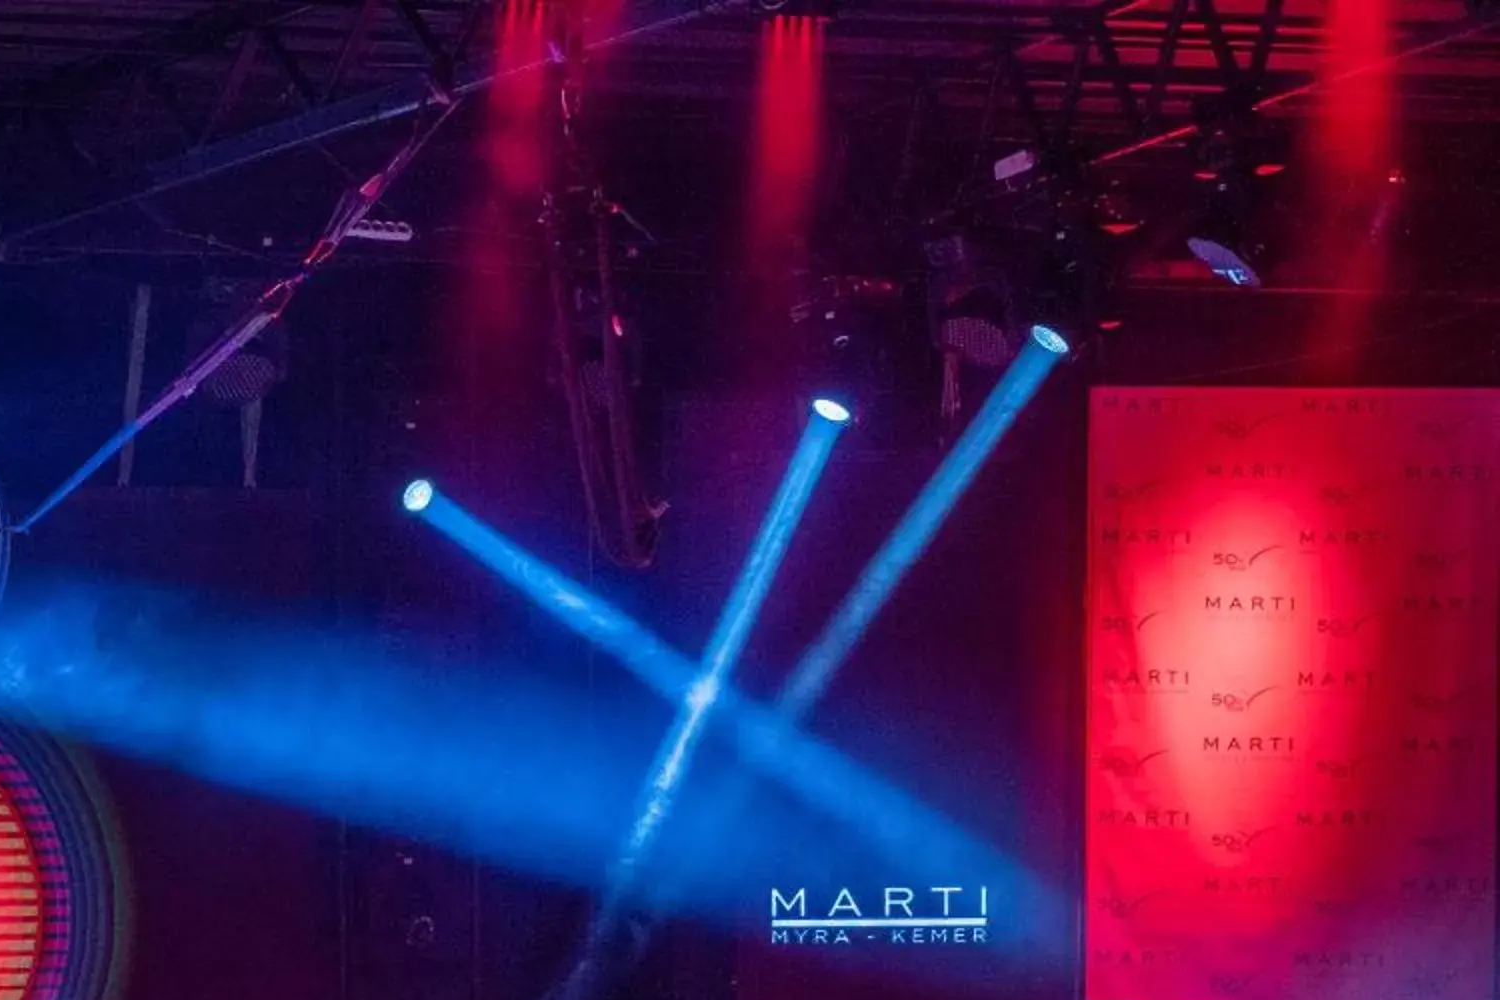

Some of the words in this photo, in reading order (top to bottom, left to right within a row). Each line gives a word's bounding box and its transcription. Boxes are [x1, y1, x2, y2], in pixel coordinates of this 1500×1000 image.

[1101, 530, 1192, 546] MARTI
[1205, 596, 1295, 611] MARTI
[1101, 669, 1190, 685] MARTI
[1203, 737, 1293, 752] MARTI
[1099, 810, 1190, 827] MARTI
[771, 886, 988, 917] MARTI
[771, 929, 850, 944] MYRA
[891, 927, 988, 944] KEMER
